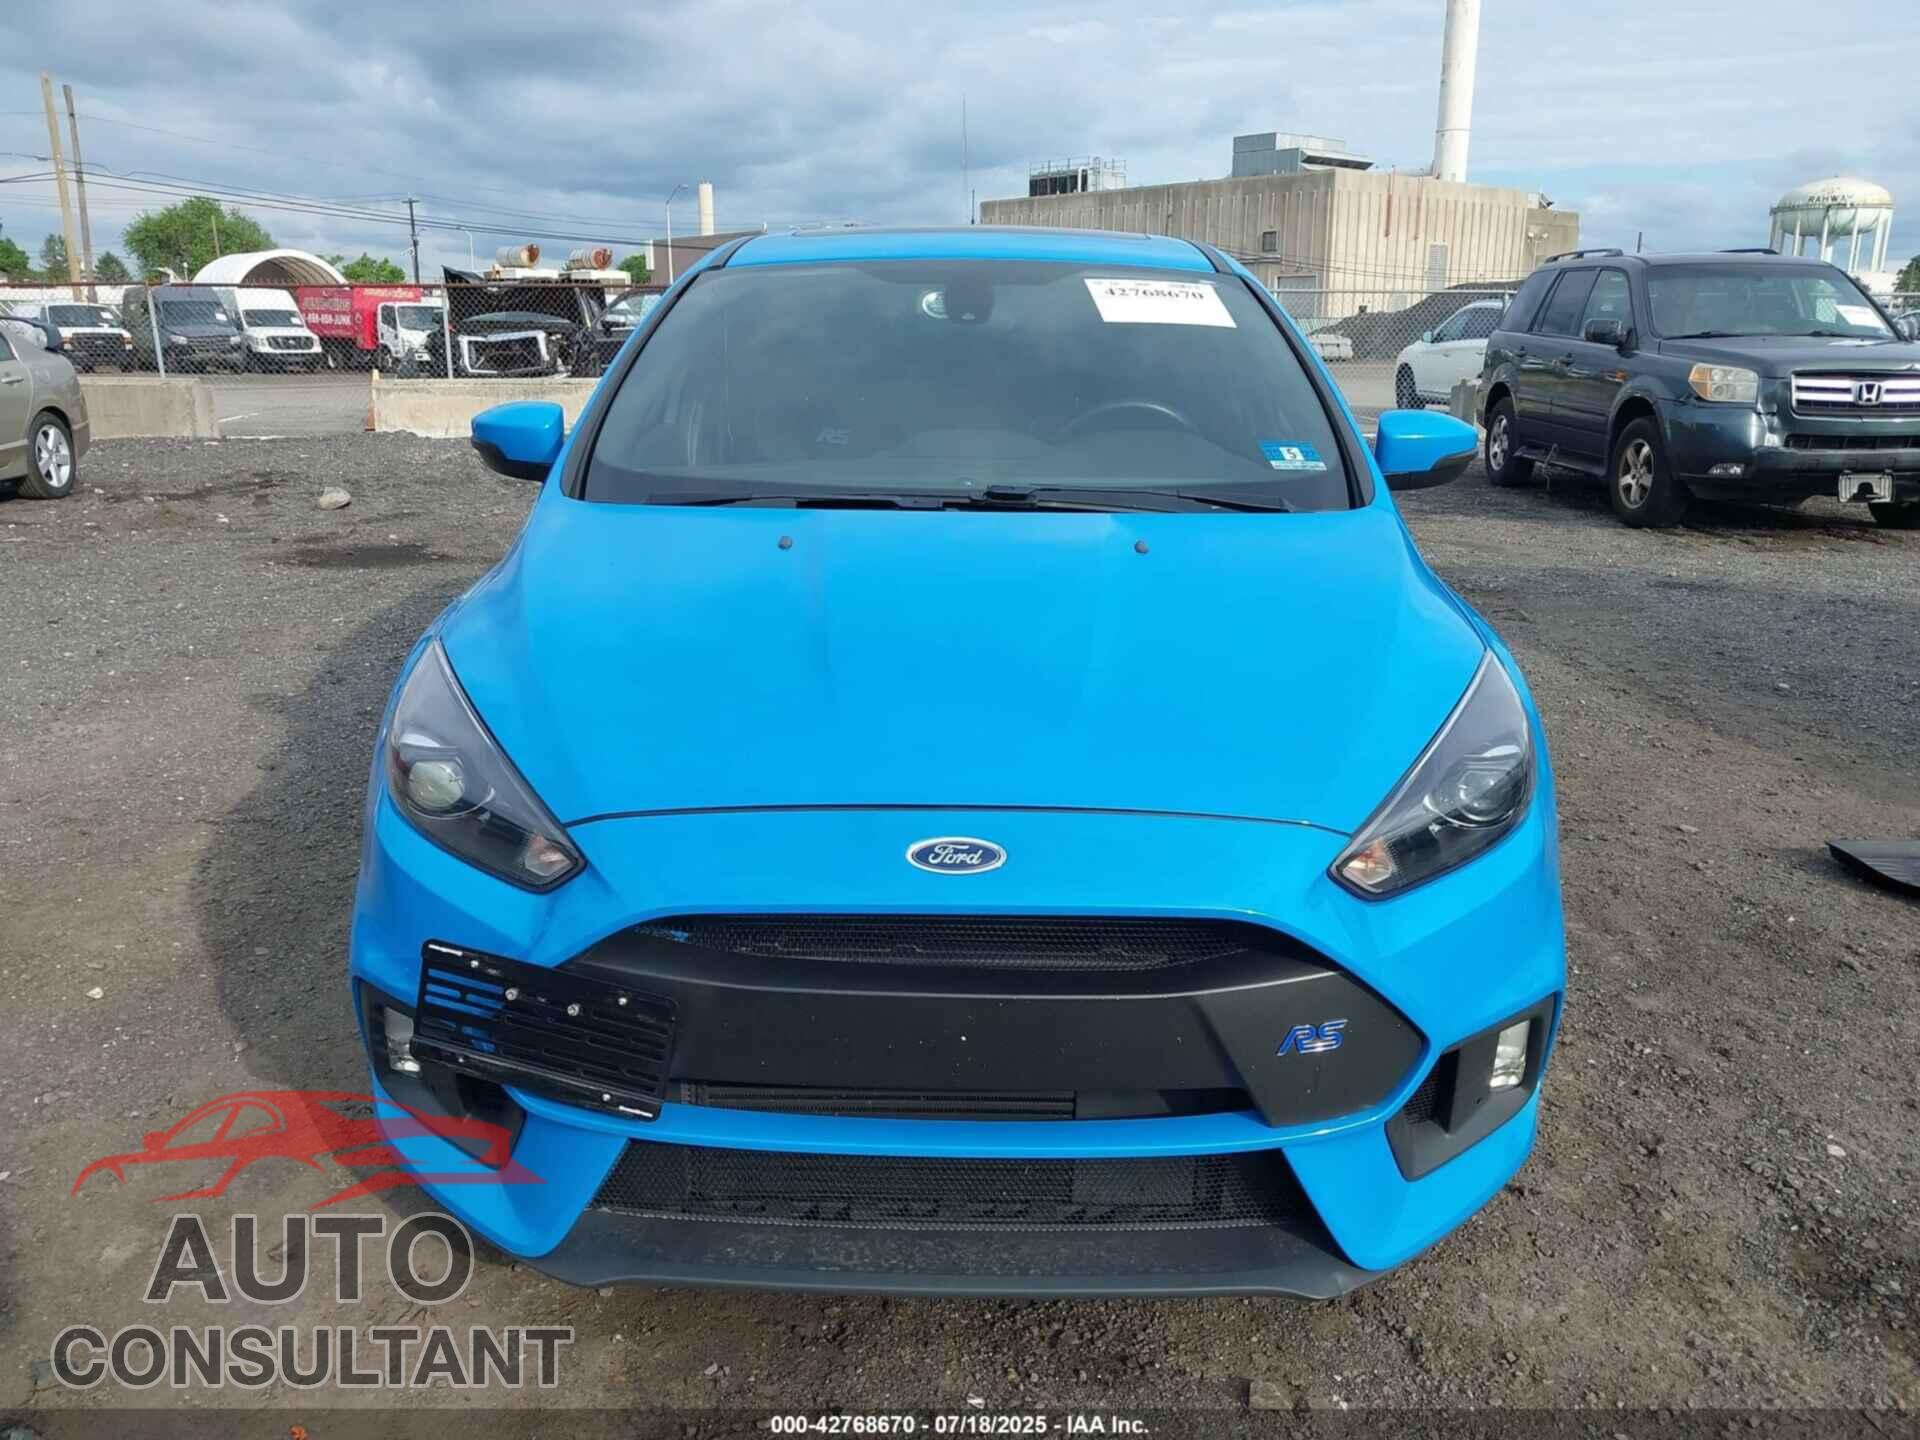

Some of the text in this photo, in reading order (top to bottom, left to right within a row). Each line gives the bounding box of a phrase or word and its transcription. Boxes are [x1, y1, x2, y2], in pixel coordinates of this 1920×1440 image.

[1808, 194, 1854, 203] RAHWAY
[1105, 287, 1204, 300] 42768670
[928, 844, 983, 865] Ford
[1276, 1019, 1348, 1056] RS
